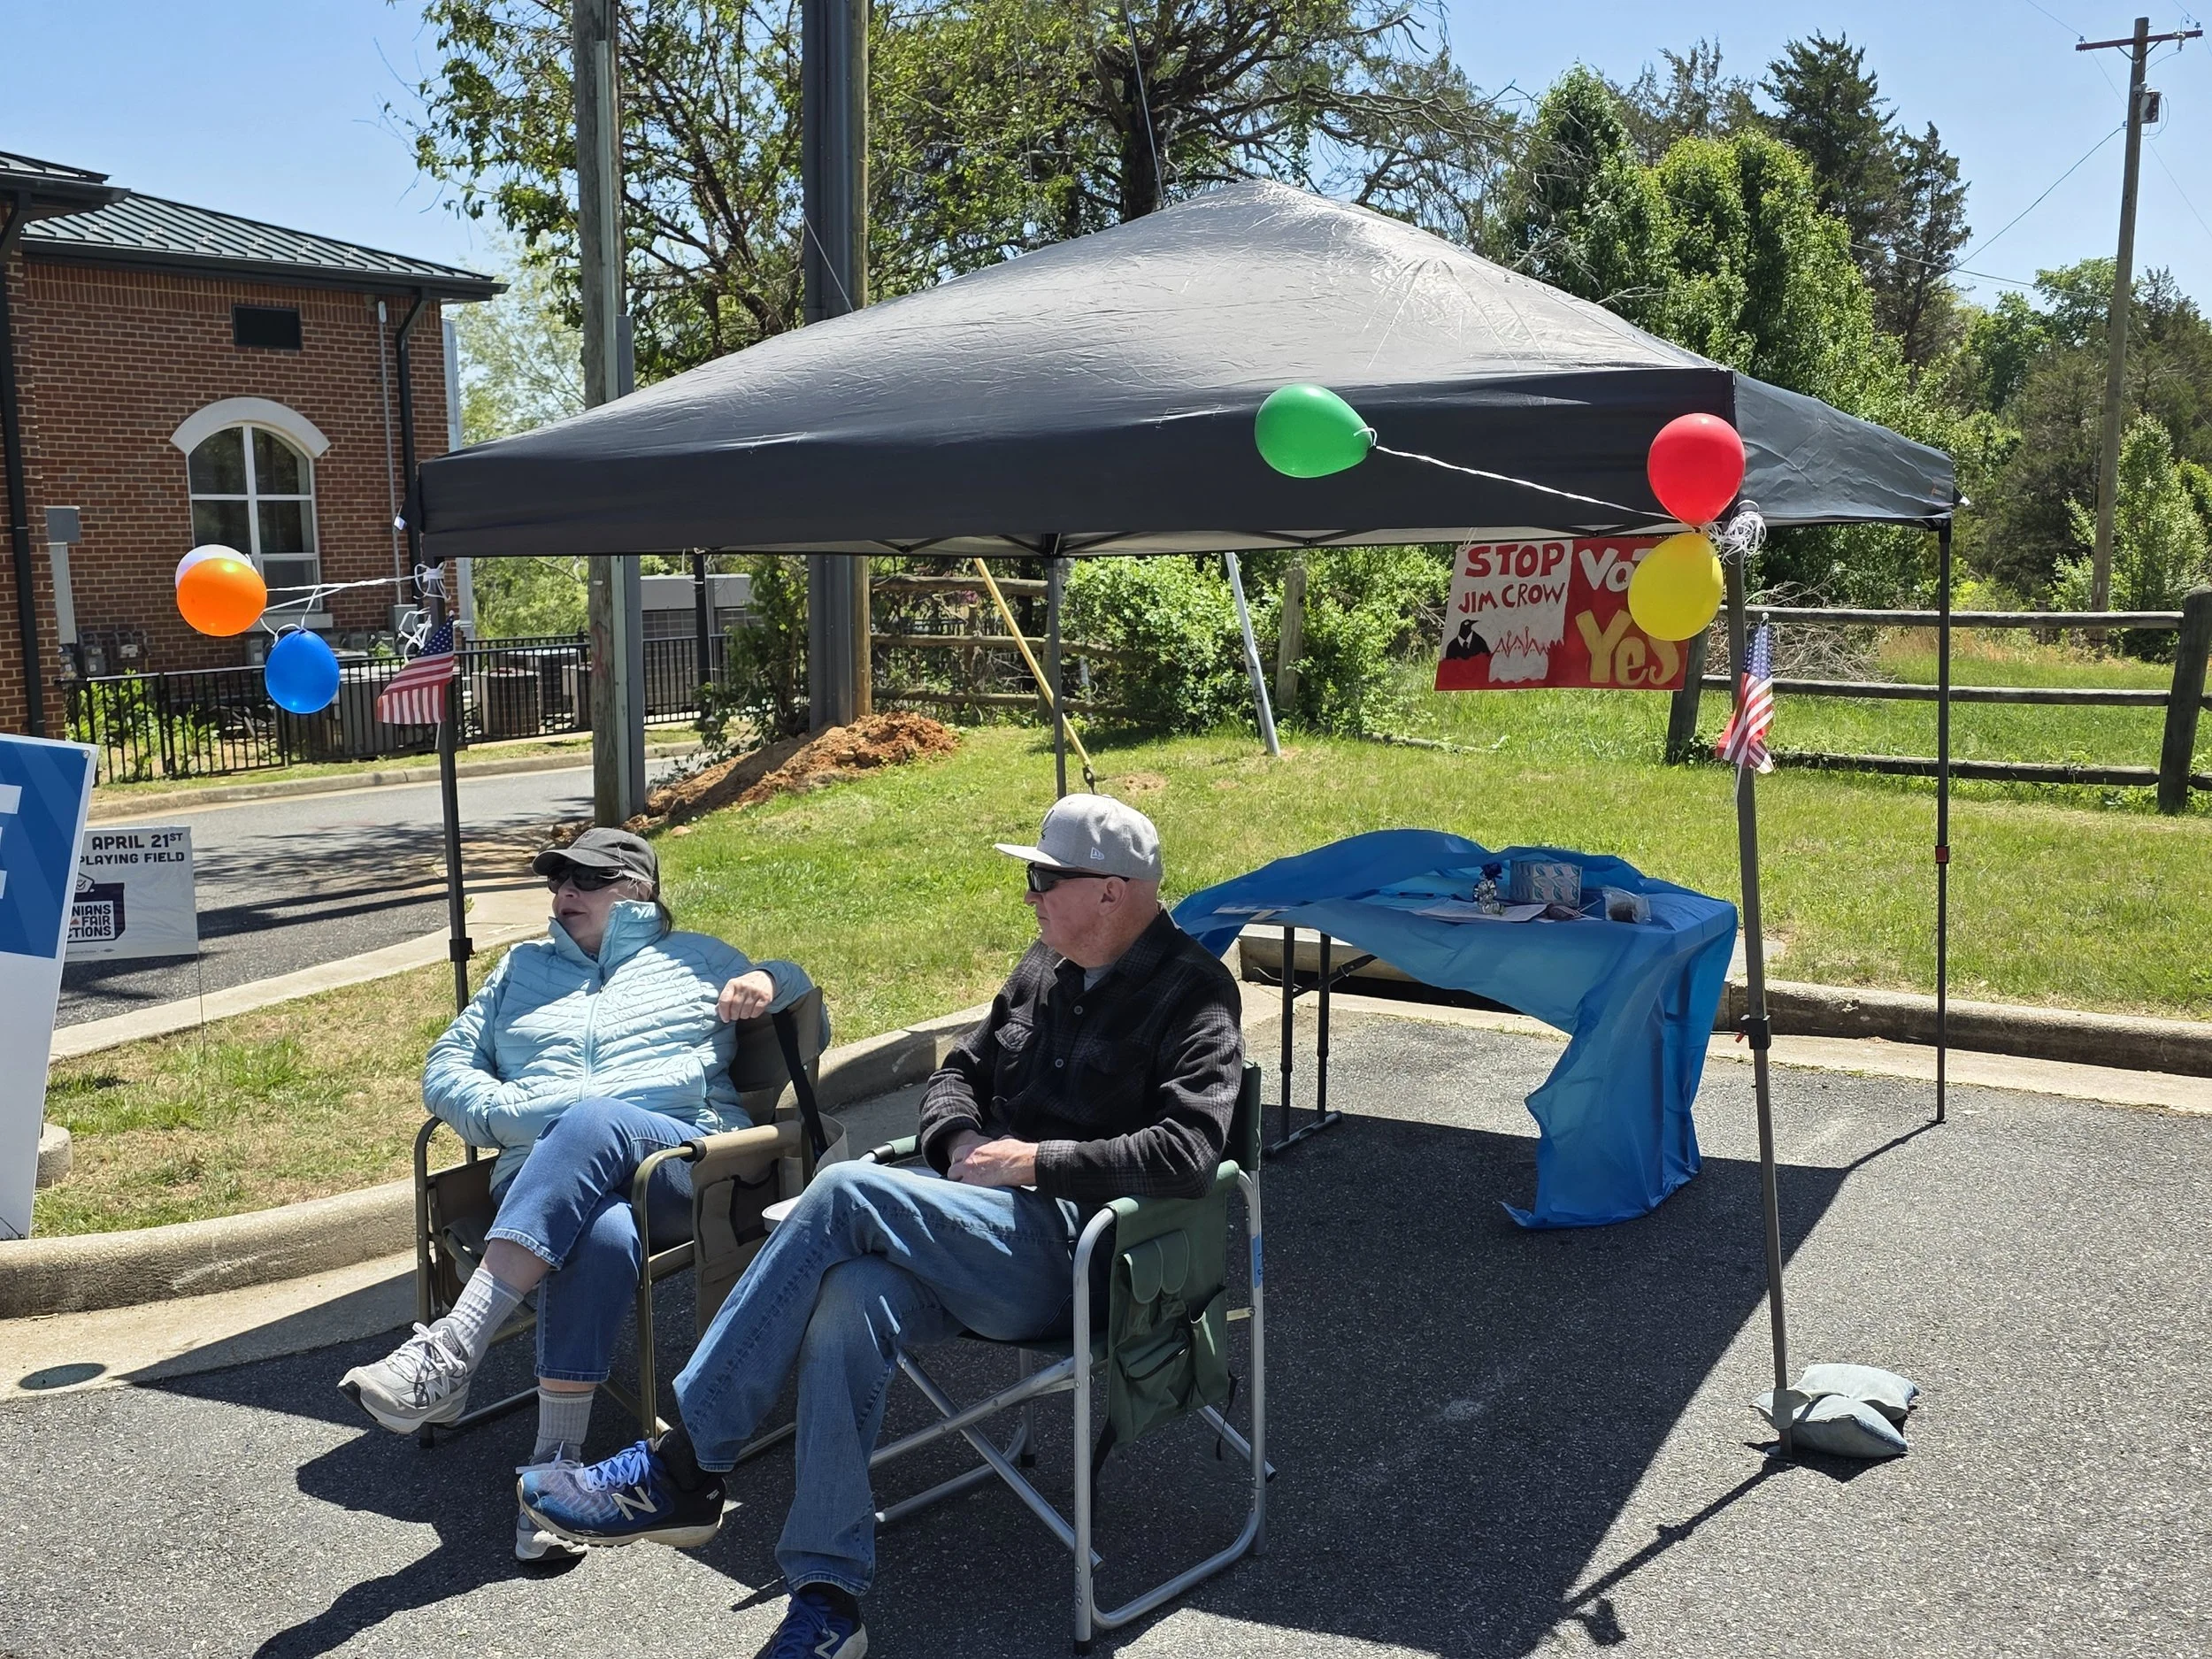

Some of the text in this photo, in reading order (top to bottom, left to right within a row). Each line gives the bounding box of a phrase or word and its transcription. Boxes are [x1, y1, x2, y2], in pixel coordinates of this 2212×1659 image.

[1464, 542, 1566, 578] STOP
[1458, 581, 1566, 614] JIM CROW
[92, 833, 183, 850] APRIL 21ST
[144, 851, 185, 864] FIELD
[72, 904, 111, 917] NIANS
[81, 915, 111, 926] FAIR
[611, 1485, 658, 1522] N
